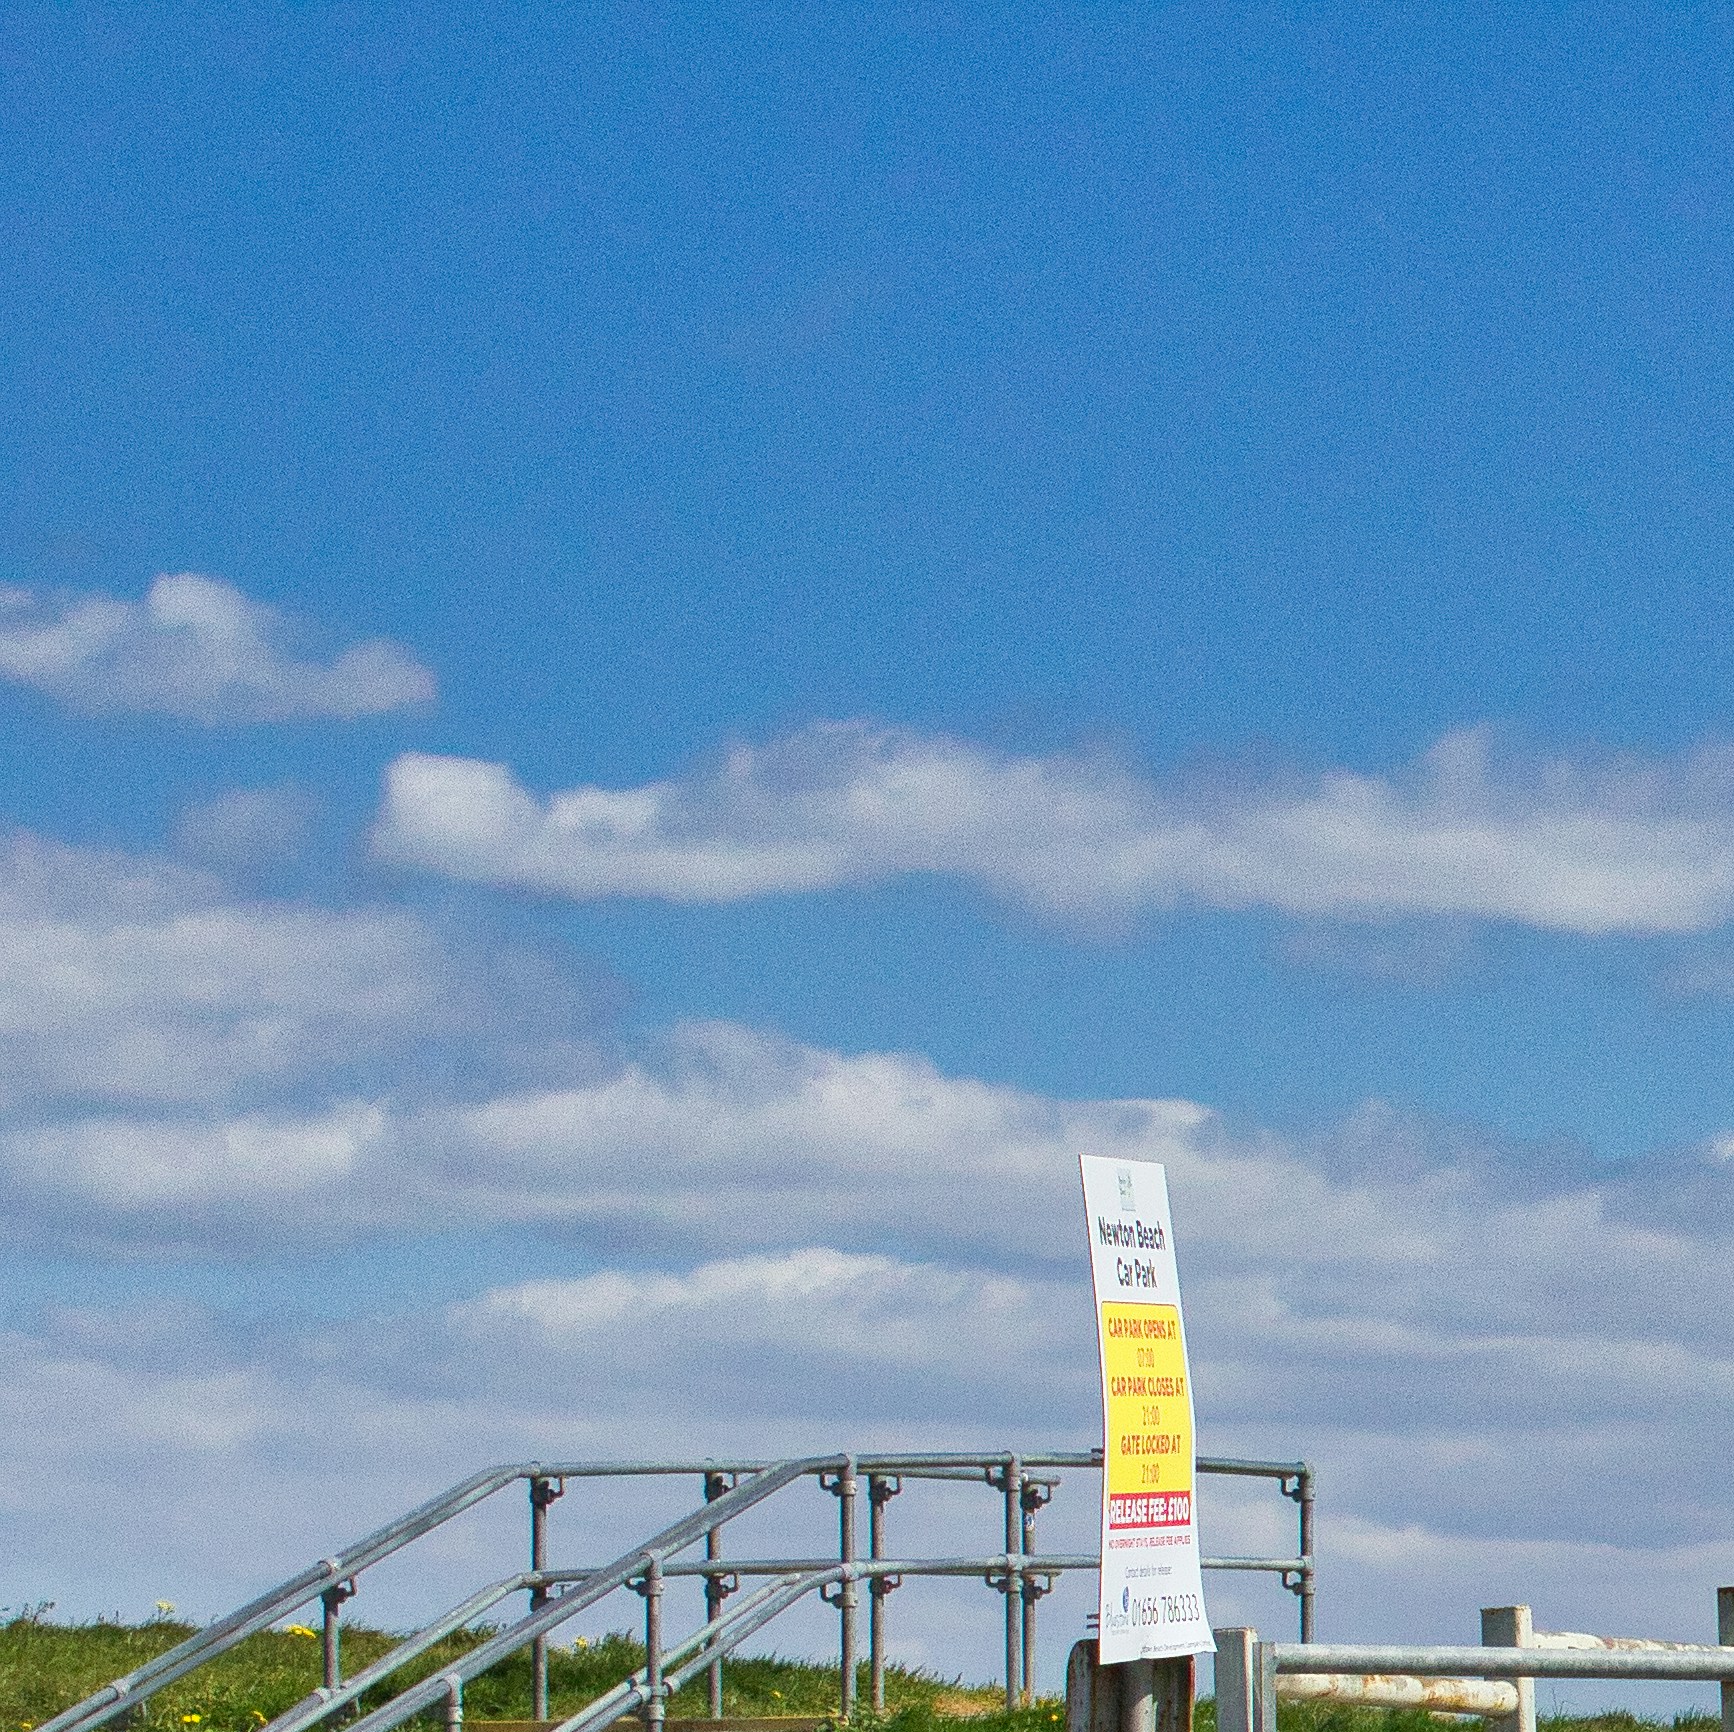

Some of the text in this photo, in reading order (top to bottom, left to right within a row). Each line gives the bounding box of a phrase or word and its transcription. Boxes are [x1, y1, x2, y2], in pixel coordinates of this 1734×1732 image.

[1098, 1216, 1166, 1250] Newton Beach
[1116, 1257, 1158, 1288] Car Park
[1109, 1318, 1176, 1339] CAR PARK OPENS AT
[1112, 1377, 1184, 1397] CAR PARK CLOSES AT
[1121, 1434, 1181, 1455] GATE LOCKED AT
[1110, 1499, 1148, 1524] RELEASE
[1168, 1497, 1189, 1521] £100
[1132, 1598, 1158, 1626] 01656
[1161, 1594, 1200, 1624] 786333
